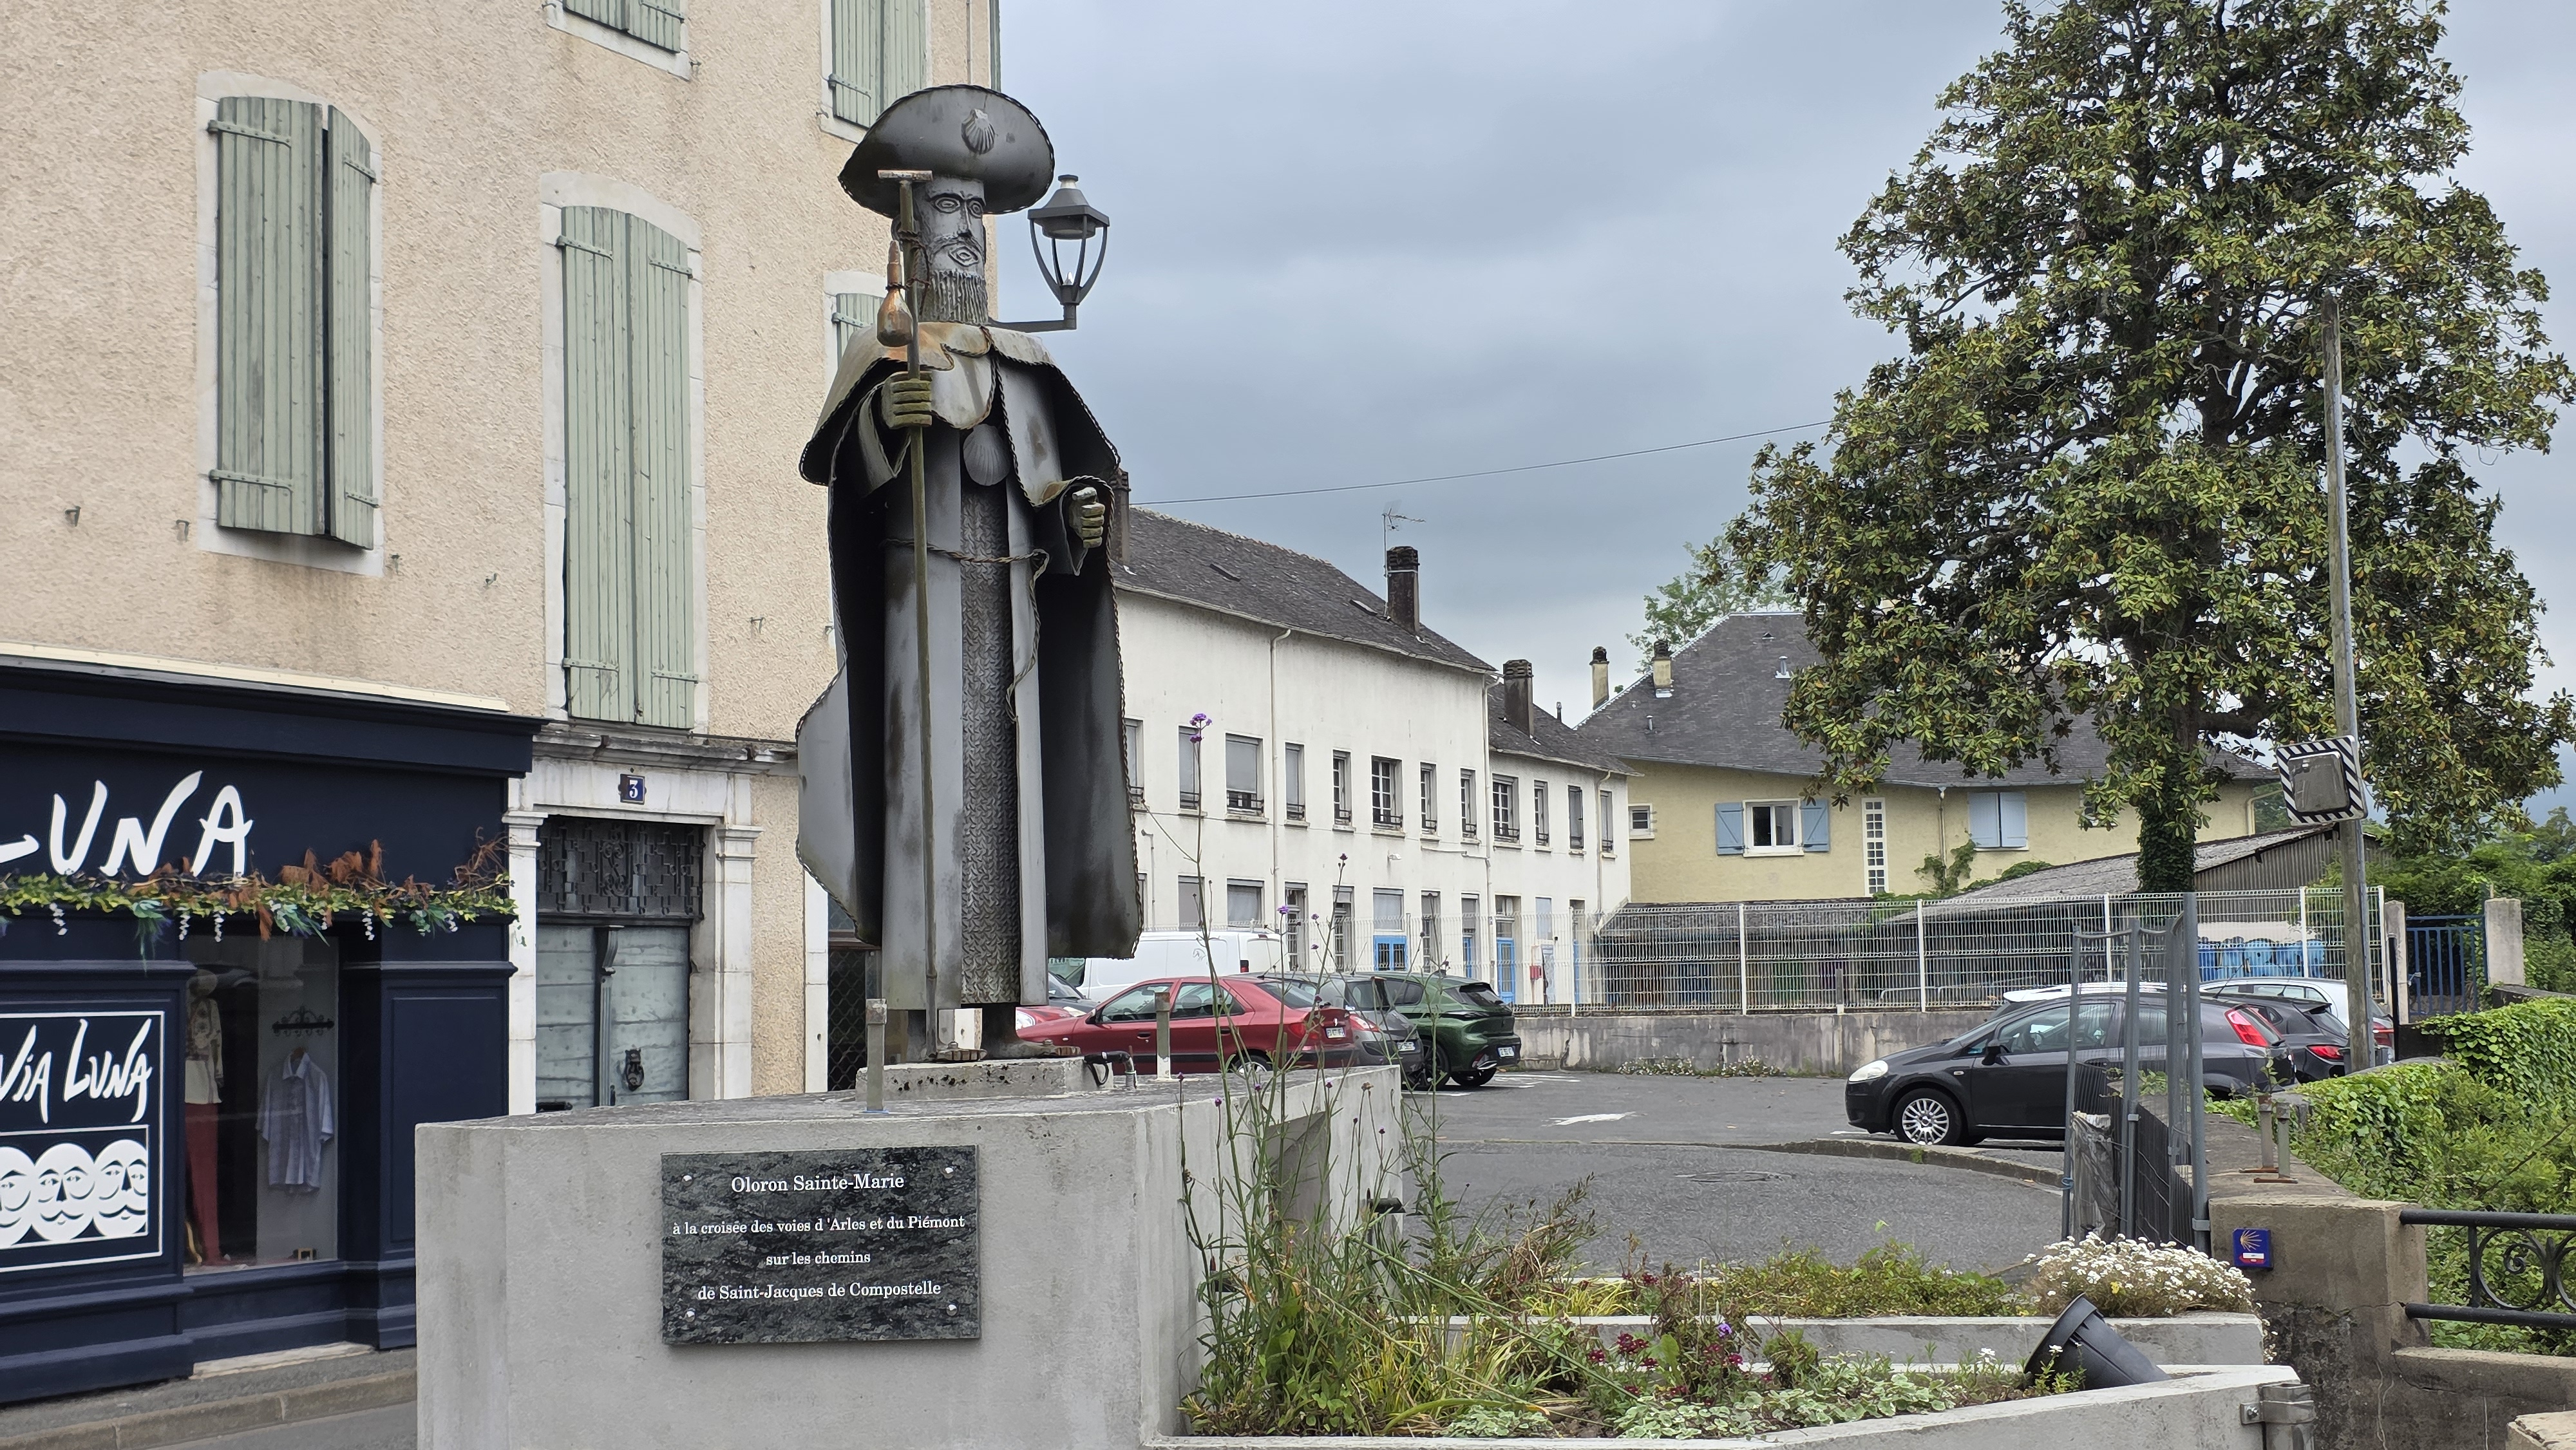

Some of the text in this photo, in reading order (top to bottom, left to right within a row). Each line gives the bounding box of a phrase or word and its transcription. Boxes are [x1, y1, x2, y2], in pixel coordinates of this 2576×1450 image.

[629, 780, 638, 798] 3
[0, 771, 254, 877] UNA
[731, 1172, 905, 1192] Oloron Sainte-Marie
[672, 1222, 681, 1235] à
[685, 1221, 697, 1234] la
[701, 1221, 747, 1234] croisée
[750, 1219, 773, 1233] des
[777, 1219, 811, 1232] voies
[869, 1217, 884, 1230] et
[886, 1216, 904, 1229] du
[907, 1215, 965, 1229] Piémont
[766, 1250, 871, 1266] sur les chemins
[697, 1280, 942, 1301] de Saint-Jacques de Compostelle
